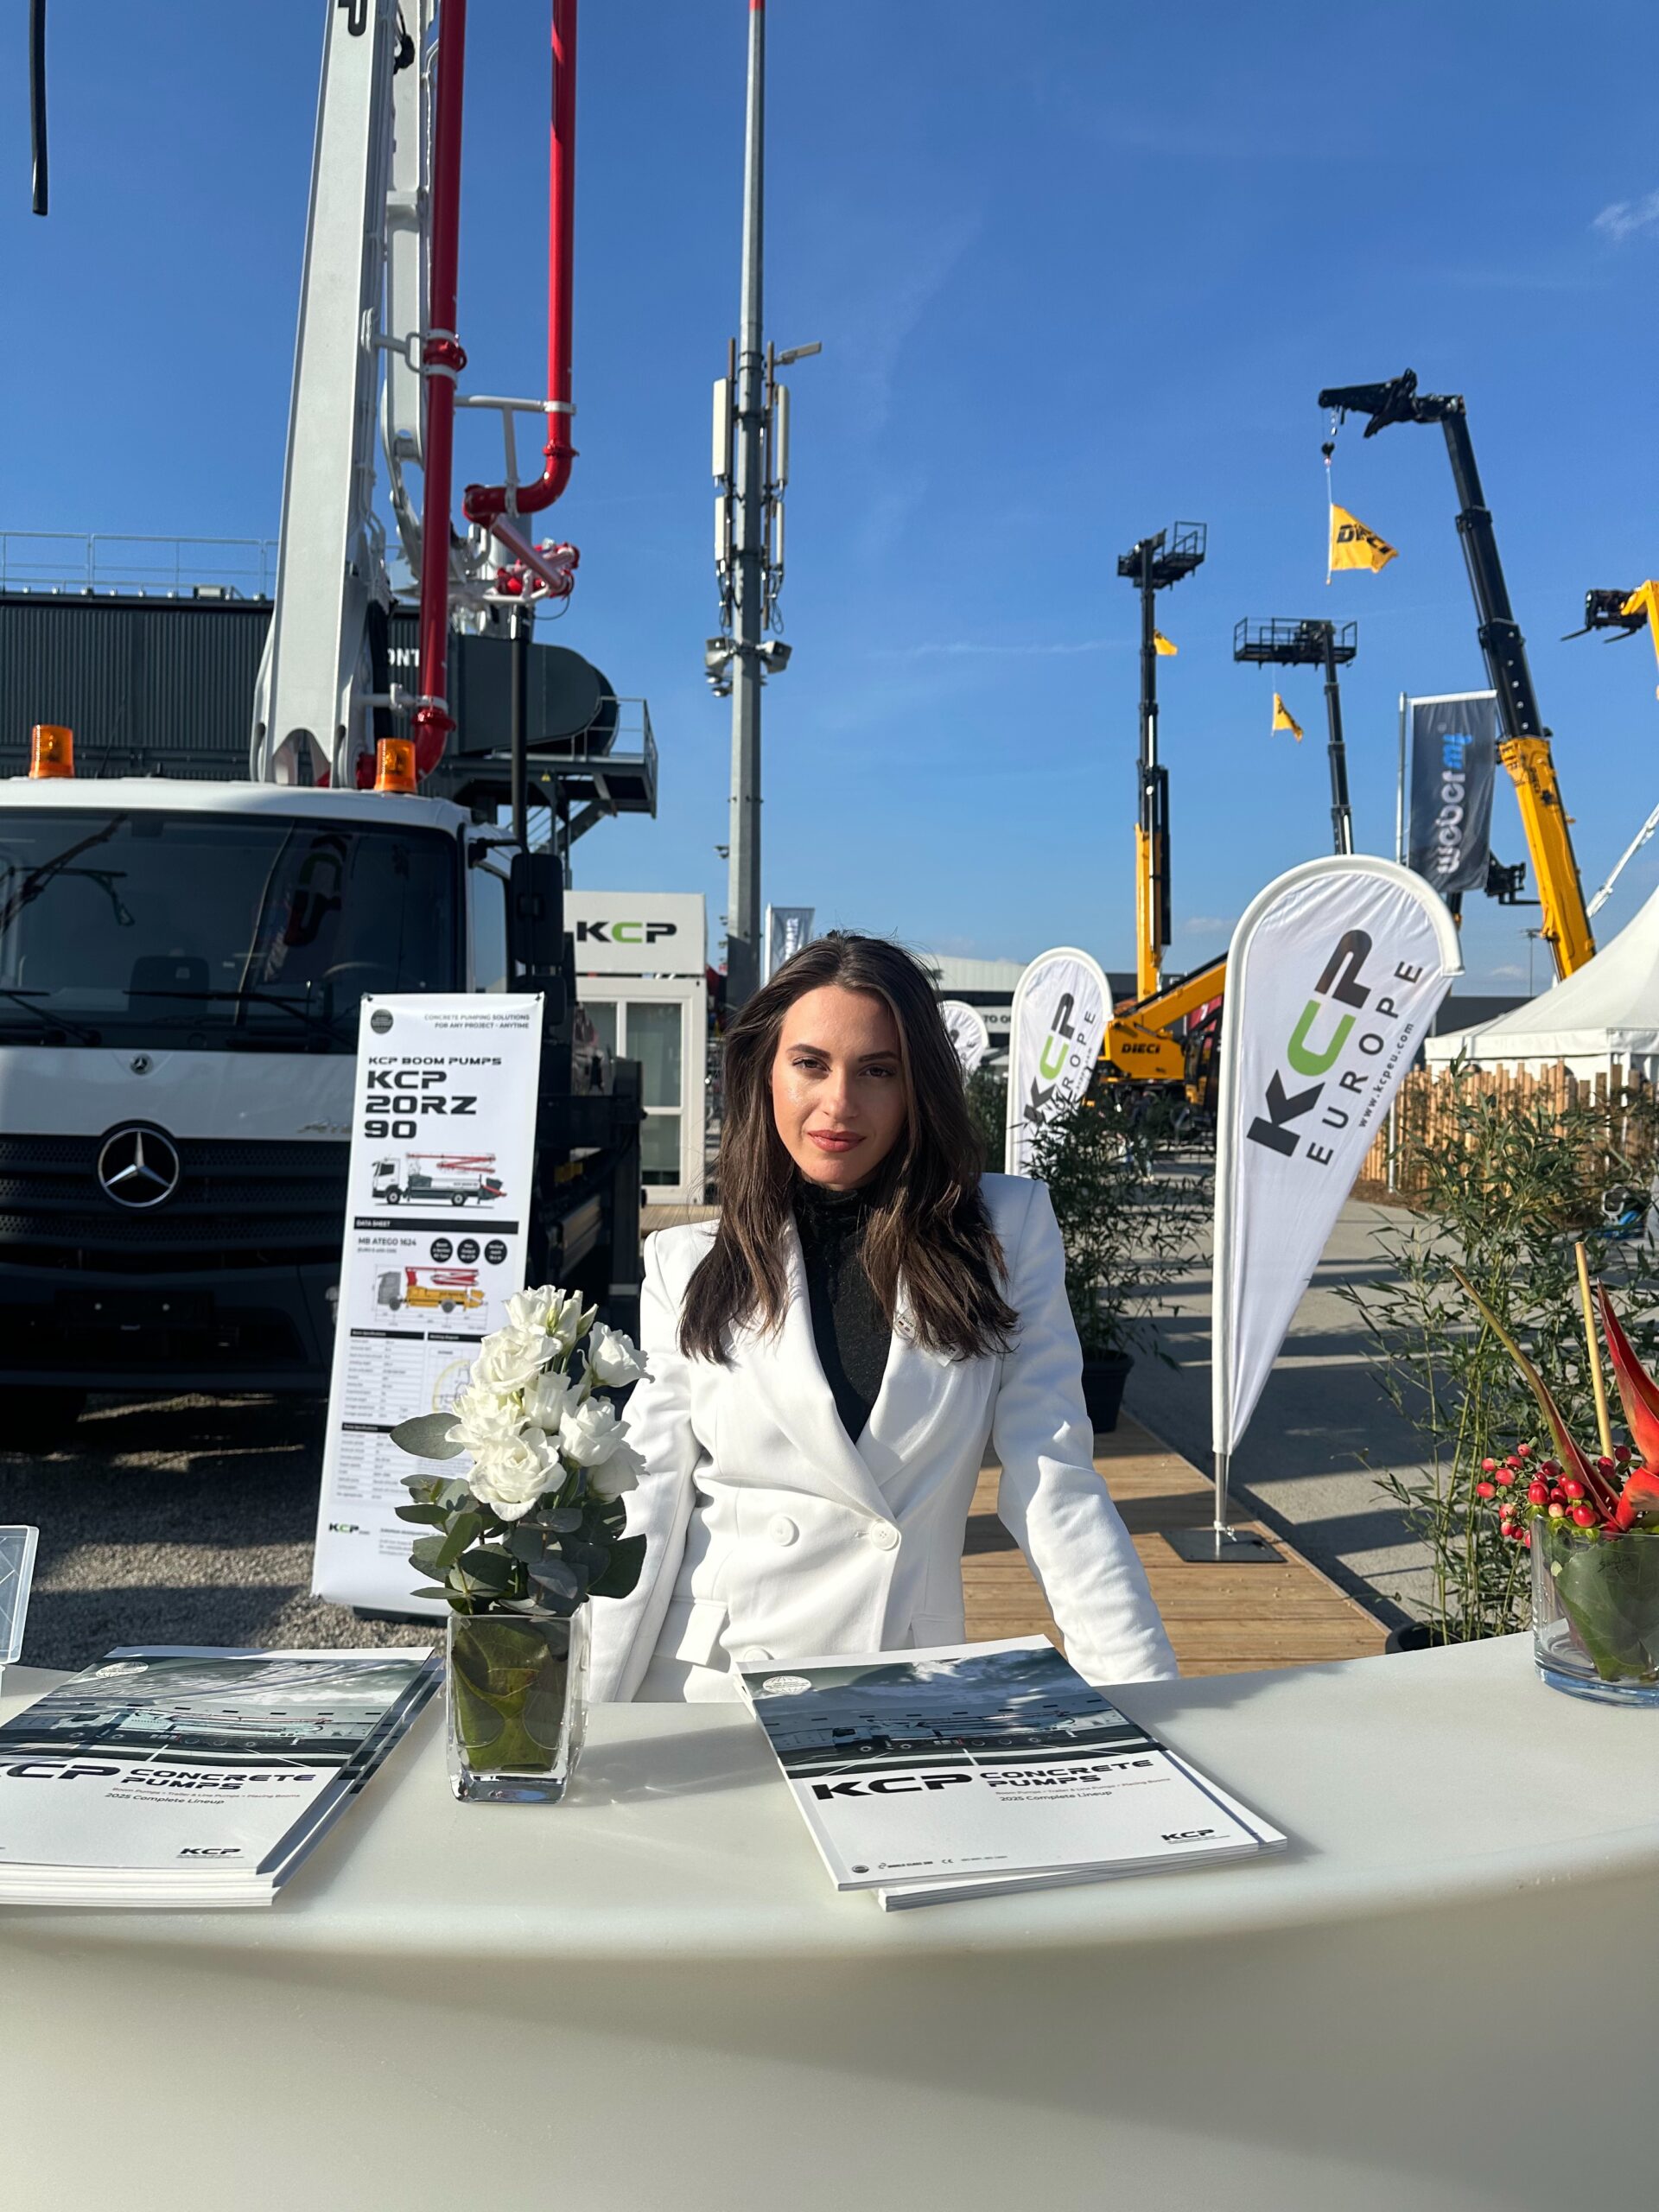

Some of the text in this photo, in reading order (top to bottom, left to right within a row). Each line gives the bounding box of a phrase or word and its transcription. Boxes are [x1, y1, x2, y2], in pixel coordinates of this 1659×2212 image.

[576, 921, 677, 944] KCP
[1122, 1044, 1161, 1054] DIECI
[1246, 929, 1373, 1158] KCP
[369, 1057, 502, 1065] KCP BOOM PUMPS
[1023, 992, 1075, 1122] KCP
[1306, 961, 1424, 1166] EUROPE
[367, 1071, 447, 1089] KCP
[1357, 1022, 1414, 1128] www.kcpeu.com
[365, 1096, 478, 1116] 20RZ
[364, 1120, 417, 1139] 90
[329, 1522, 359, 1533] KCP
[0, 1763, 316, 1781] CP CONCRETE
[811, 1759, 1154, 1801] KCP CONCRETE
[121, 1777, 244, 1790] PUMPS
[987, 1775, 1102, 1788] PUMPS
[1160, 1828, 1215, 1841] KCP
